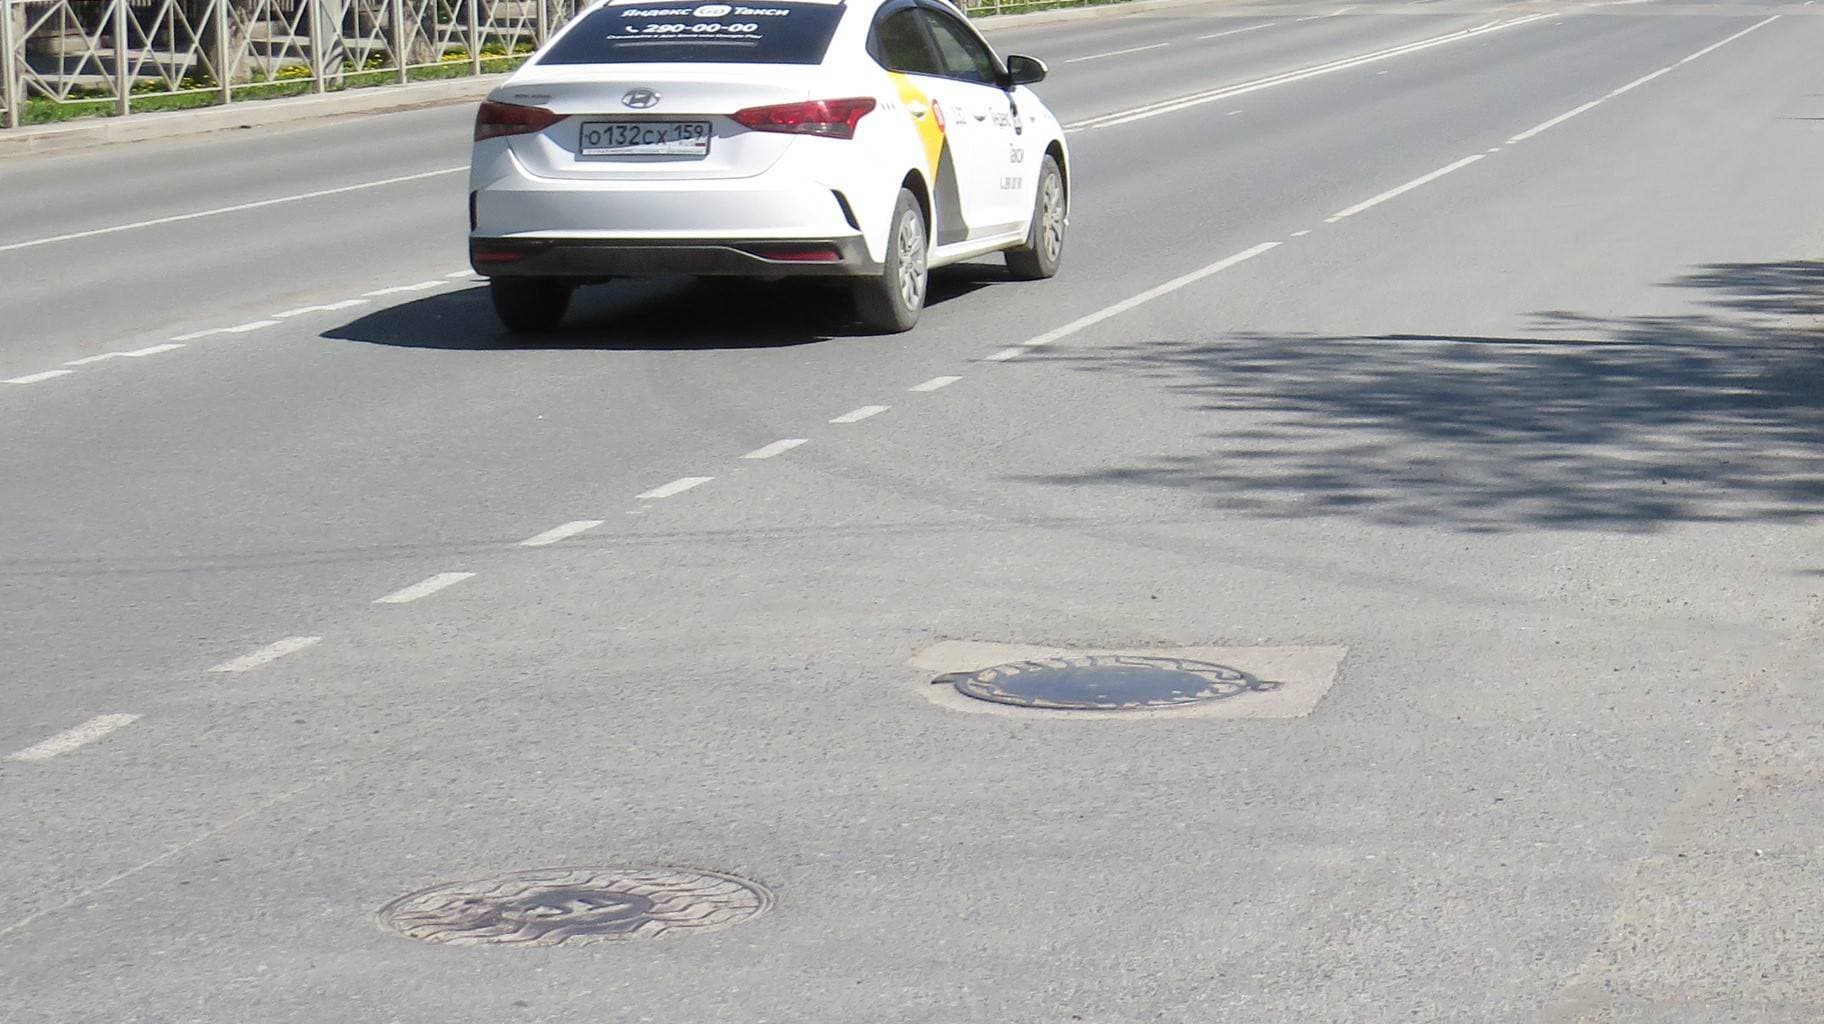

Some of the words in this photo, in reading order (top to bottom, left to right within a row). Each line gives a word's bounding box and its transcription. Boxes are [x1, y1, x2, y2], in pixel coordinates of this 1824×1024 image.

[621, 9, 692, 17] Яндекс
[734, 7, 790, 16] Такси
[643, 23, 758, 33] 290-00-00
[675, 124, 703, 140] 159
